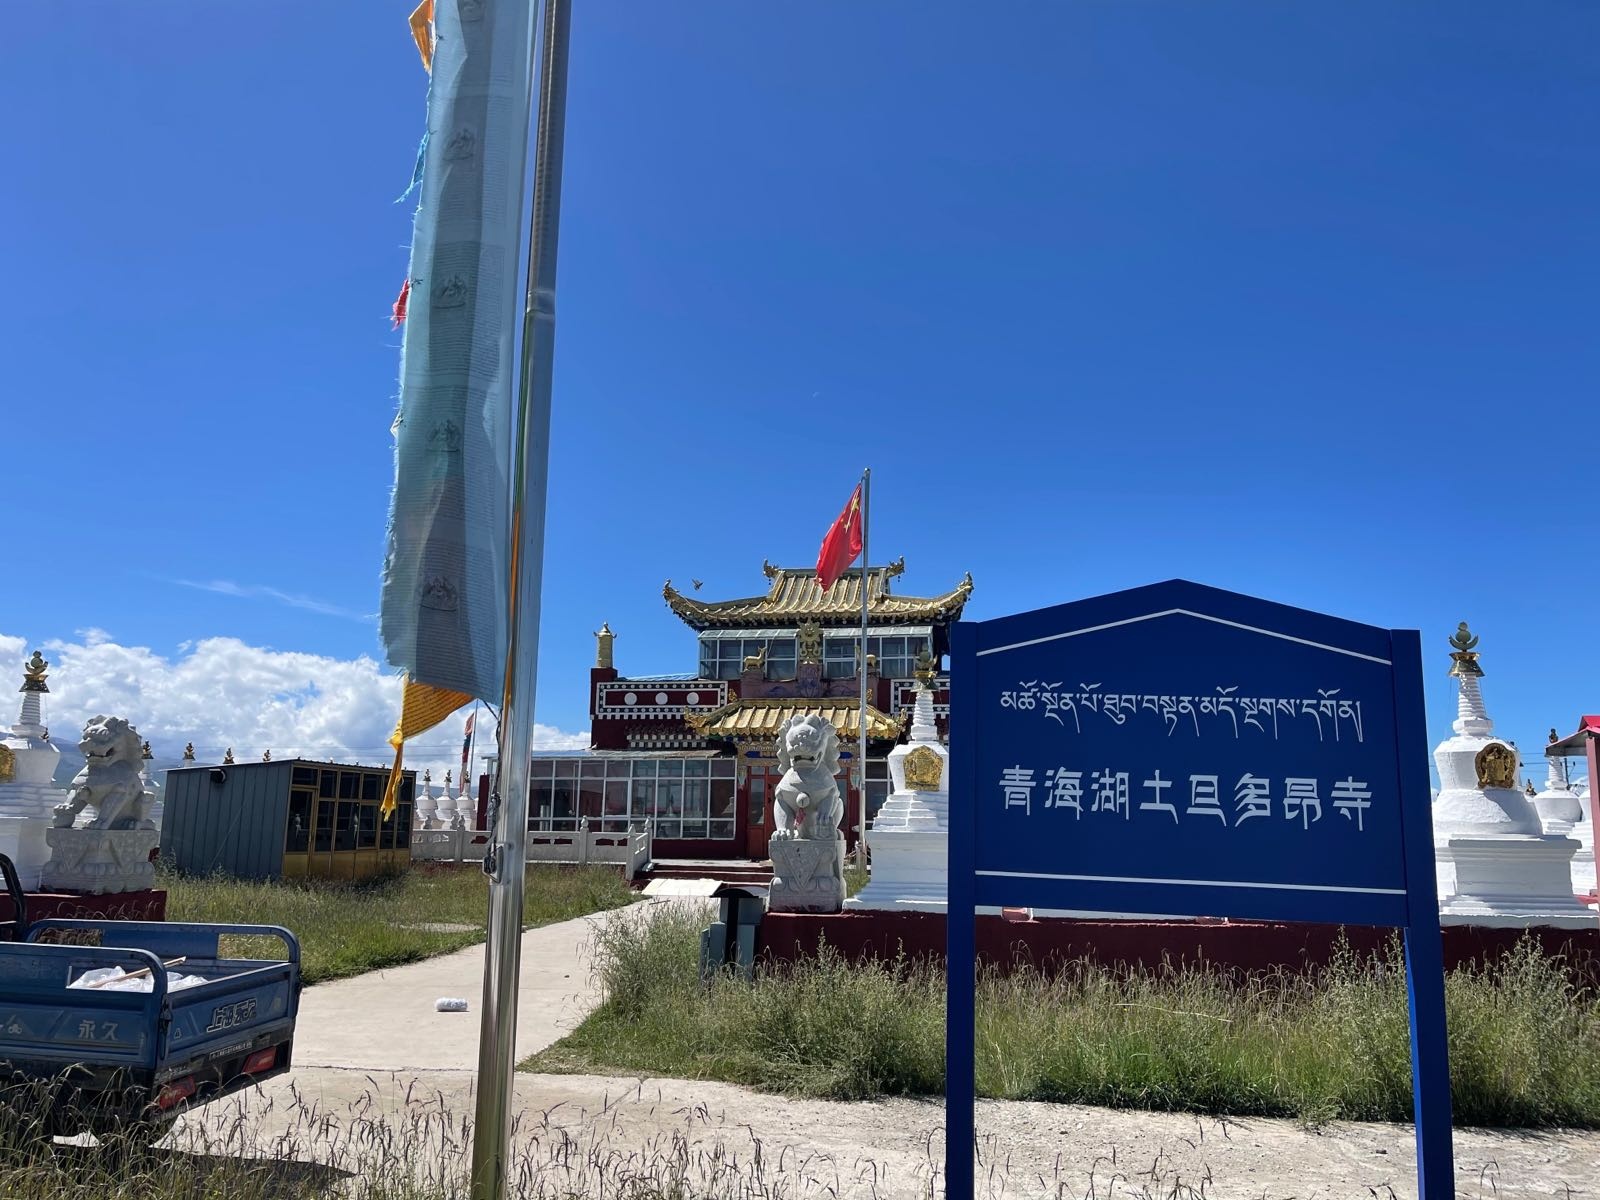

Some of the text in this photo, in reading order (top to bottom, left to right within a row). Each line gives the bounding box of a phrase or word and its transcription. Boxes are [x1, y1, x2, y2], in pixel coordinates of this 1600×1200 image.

[999, 764, 1372, 831] 青海湖土旦多昂寺
[78, 1019, 119, 1041] 永久
